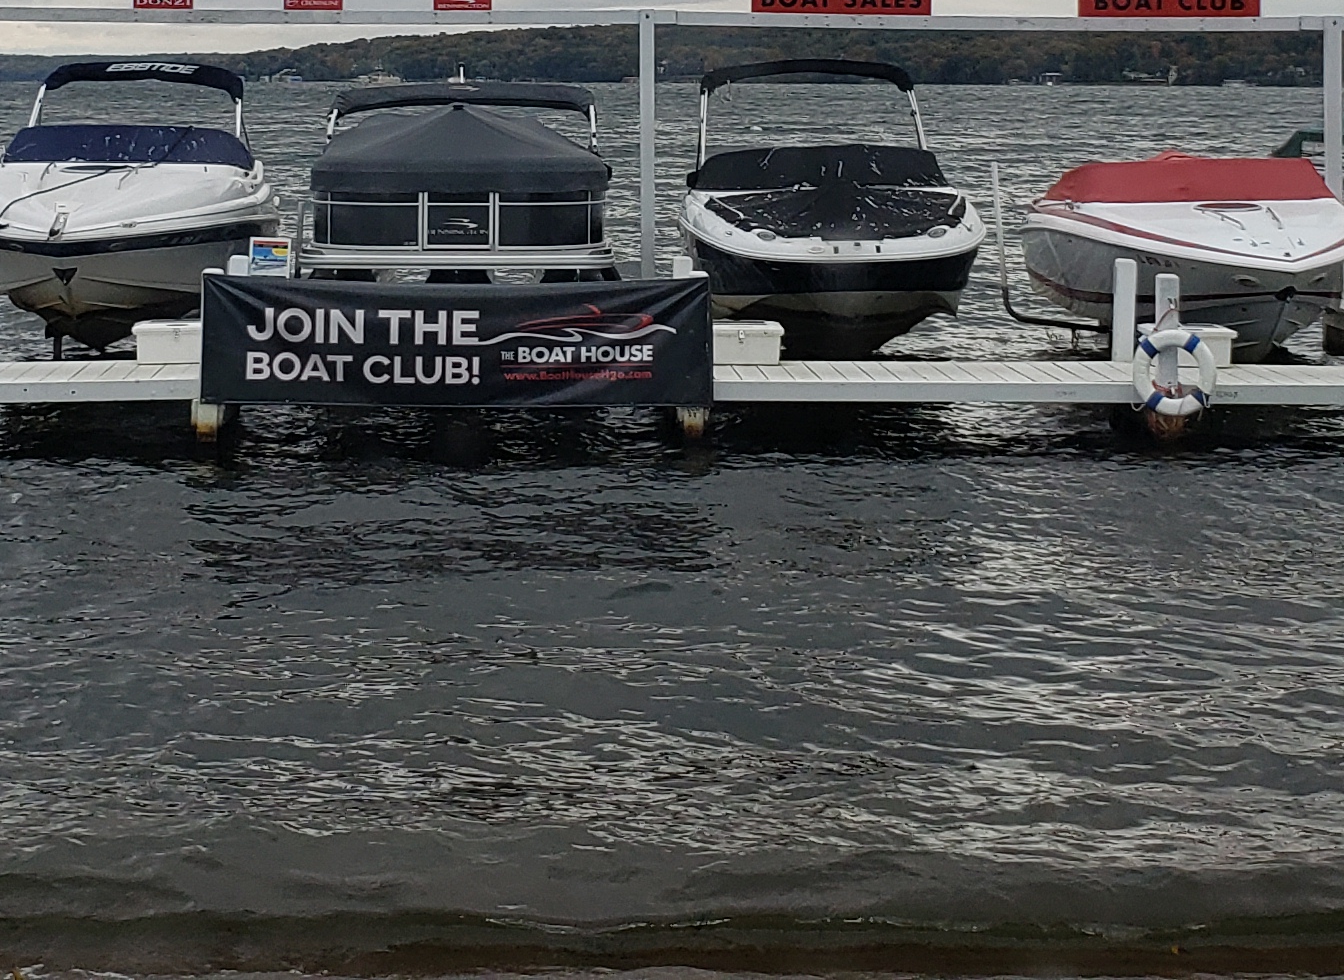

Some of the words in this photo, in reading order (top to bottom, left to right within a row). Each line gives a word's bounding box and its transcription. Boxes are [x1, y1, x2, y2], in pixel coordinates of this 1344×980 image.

[246, 307, 366, 345] JOIN
[377, 309, 481, 346] THE
[245, 350, 354, 382] BOAT
[362, 354, 481, 385] CLUB!
[500, 350, 515, 361] THE
[517, 346, 576, 364] BOAT
[580, 344, 654, 363] HOUSE
